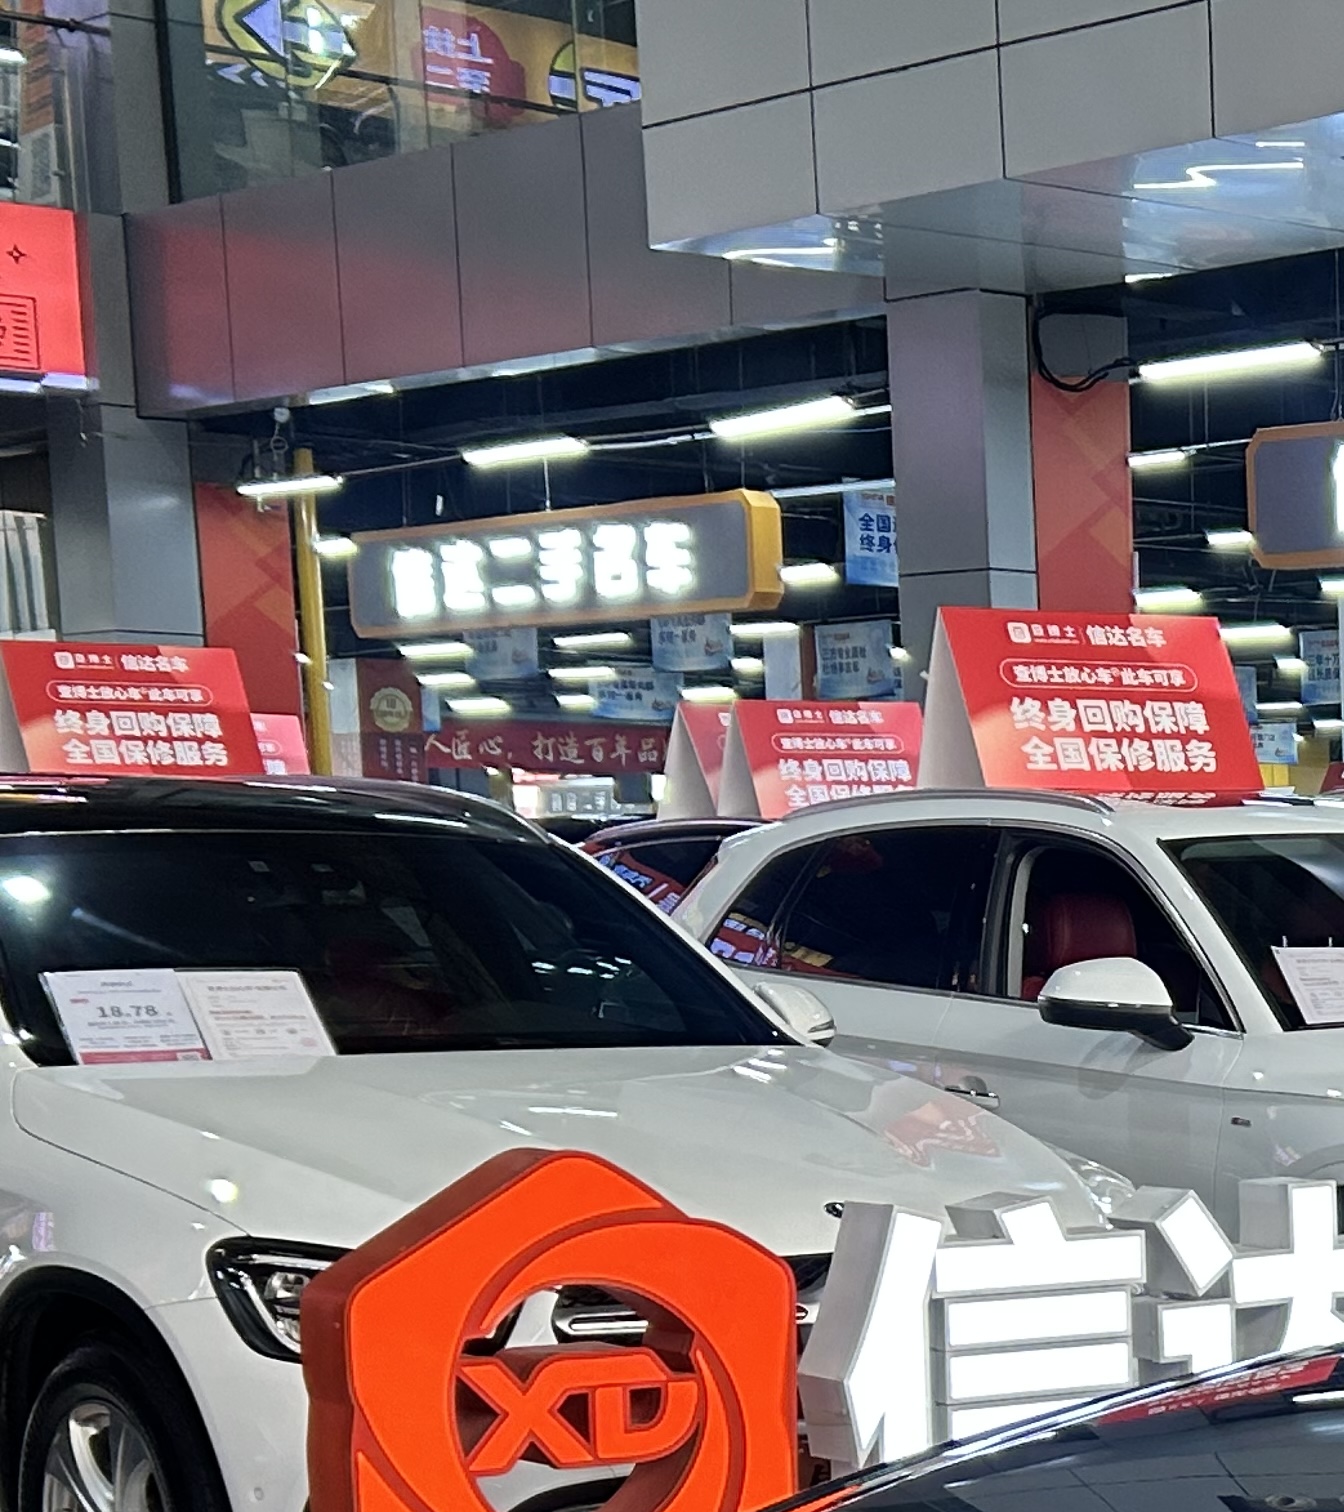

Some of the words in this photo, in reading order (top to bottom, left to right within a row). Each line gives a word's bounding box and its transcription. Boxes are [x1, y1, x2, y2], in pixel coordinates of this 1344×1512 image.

[858, 511, 897, 533] 全国
[859, 533, 897, 554] 终身
[1085, 623, 1168, 648] 信达名车
[120, 654, 191, 674] 信达名车
[53, 709, 223, 738] 终身回购保障
[1009, 697, 1211, 734] 终身回购保障
[62, 738, 229, 767] 全国保修服务
[1020, 735, 1218, 774] 全国保修服务
[778, 758, 913, 783] 终身回购保障
